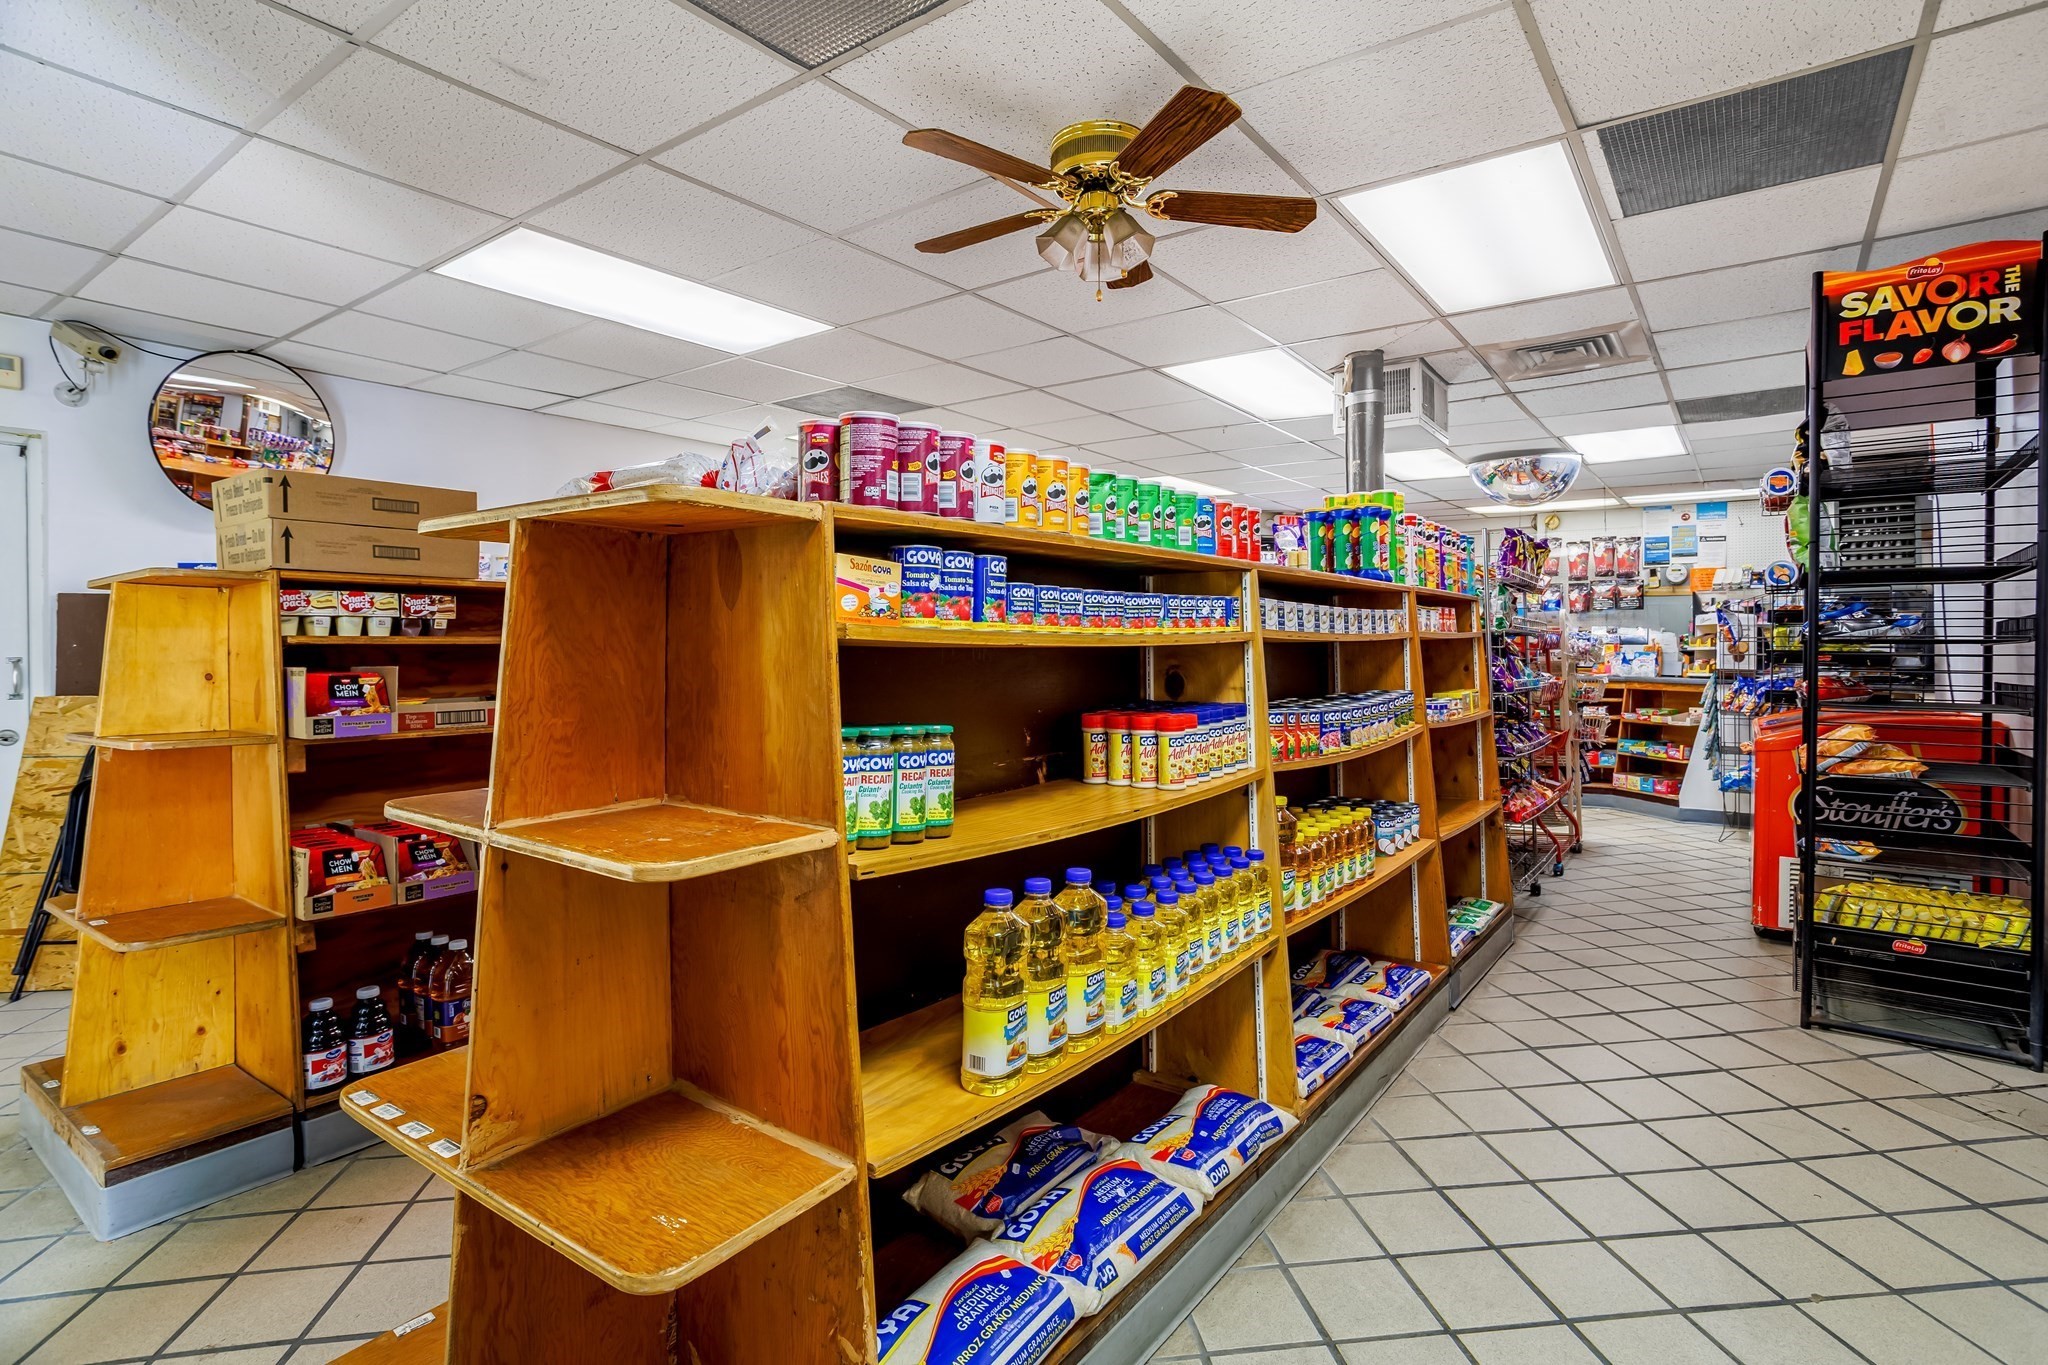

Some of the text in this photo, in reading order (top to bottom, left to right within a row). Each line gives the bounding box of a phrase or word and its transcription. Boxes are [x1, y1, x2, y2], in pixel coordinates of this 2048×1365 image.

[2005, 264, 2021, 293] THE
[1839, 270, 2000, 318] SAVOR
[1839, 296, 2022, 346] FLAVOR
[850, 558, 891, 575] Sazón GOYA
[906, 550, 941, 563] GOYA
[991, 561, 1006, 573] GO
[283, 599, 308, 609] pack
[342, 595, 371, 605] Snack
[349, 601, 371, 609] pack
[405, 597, 431, 606] Snack
[1169, 599, 1179, 607] GO
[861, 775, 893, 784] RECAIT
[329, 859, 352, 867] CHOW
[414, 848, 435, 856] CHOW
[331, 865, 353, 874] MEIN
[1132, 1115, 1178, 1142] GOYA
[1047, 1145, 1068, 1161] GRAN
[1210, 1166, 1229, 1184] OYA
[1093, 1176, 1122, 1198] MEDIUM
[1007, 1189, 1066, 1238] GOYA
[1100, 1195, 1140, 1227] ARROZ GRANO
[1139, 1203, 1181, 1241] MEDIUM GRAIN RICE
[1140, 1207, 1189, 1252] ARROZ GRANO MEDIANO
[953, 1284, 995, 1320] MEDIUM
[954, 1284, 980, 1306] Enriched
[957, 1284, 1009, 1331] GRAIN RICE
[978, 1295, 1012, 1326] Enriquecido
[952, 1275, 1048, 1365] ARROZ GRANO MEDIANO
[1010, 1315, 1061, 1365] DIUM GRAIN RICE
[1023, 1319, 1067, 1365] RANO MEDIANO
